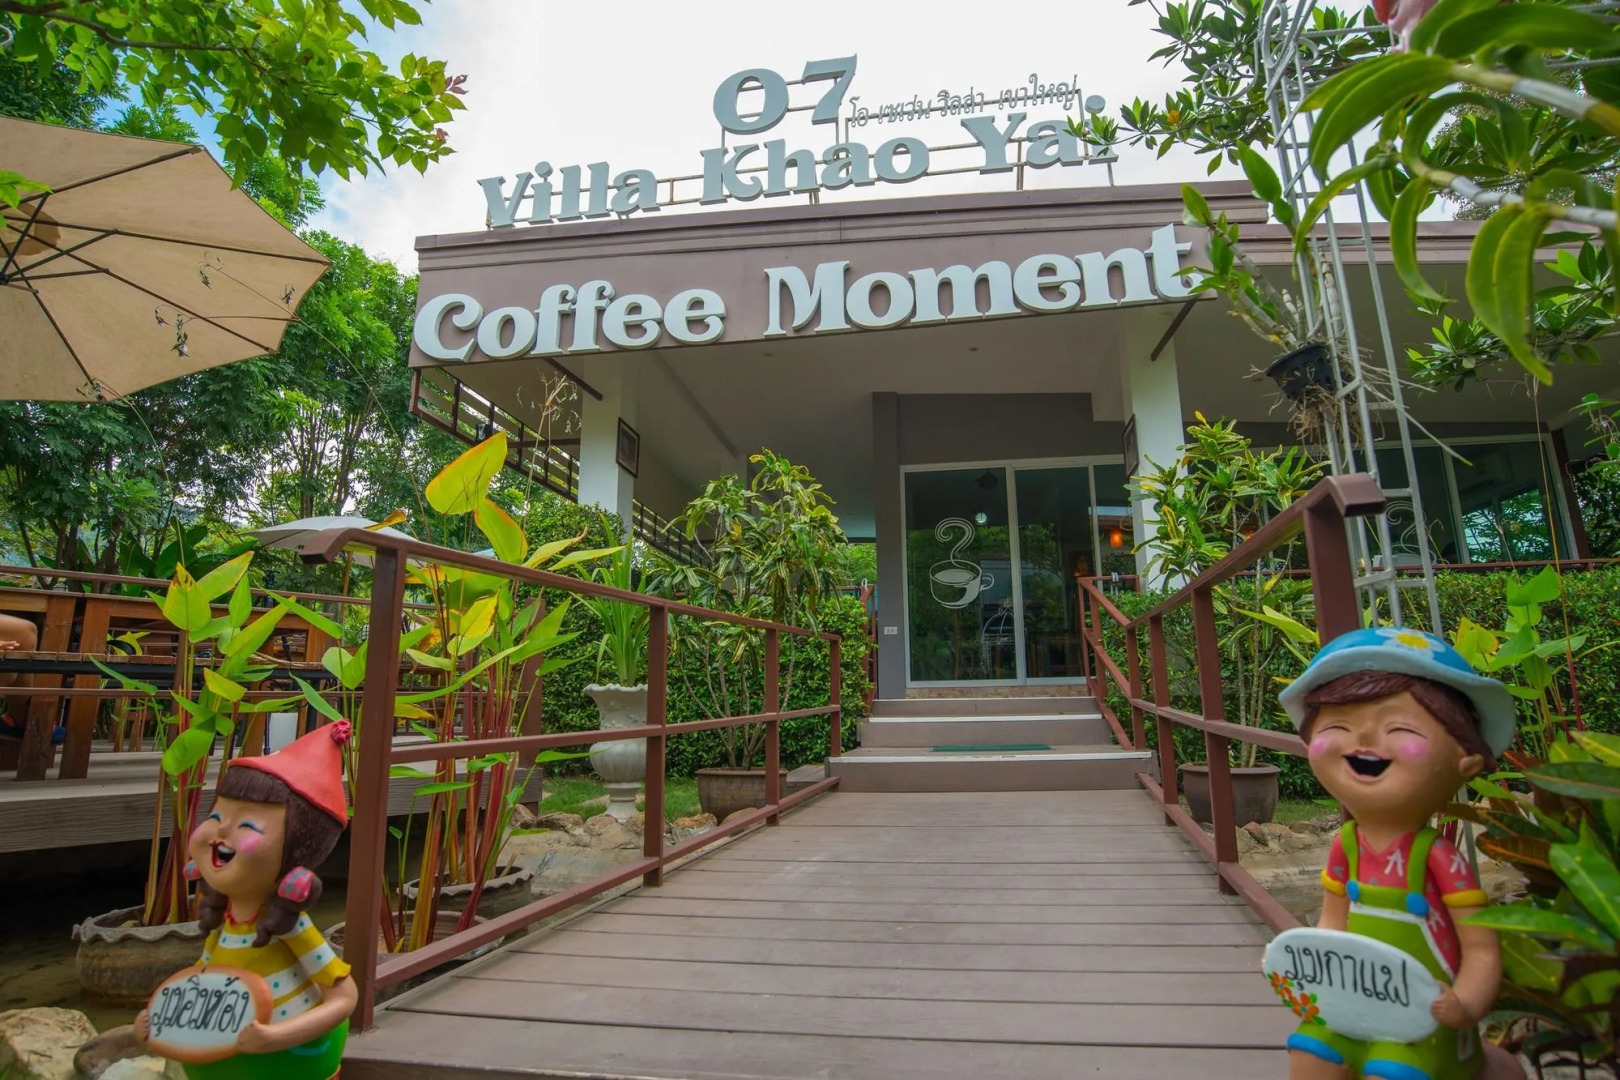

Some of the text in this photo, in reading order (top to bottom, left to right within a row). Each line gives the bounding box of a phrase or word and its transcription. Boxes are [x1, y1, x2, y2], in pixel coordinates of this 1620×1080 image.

[998, 73, 1078, 111] เขาใหญ่
[477, 94, 1120, 230] Villa Khao Yai
[413, 222, 1204, 362] Coffee Moment
[1285, 945, 1410, 1007] มุมกาแฟ
